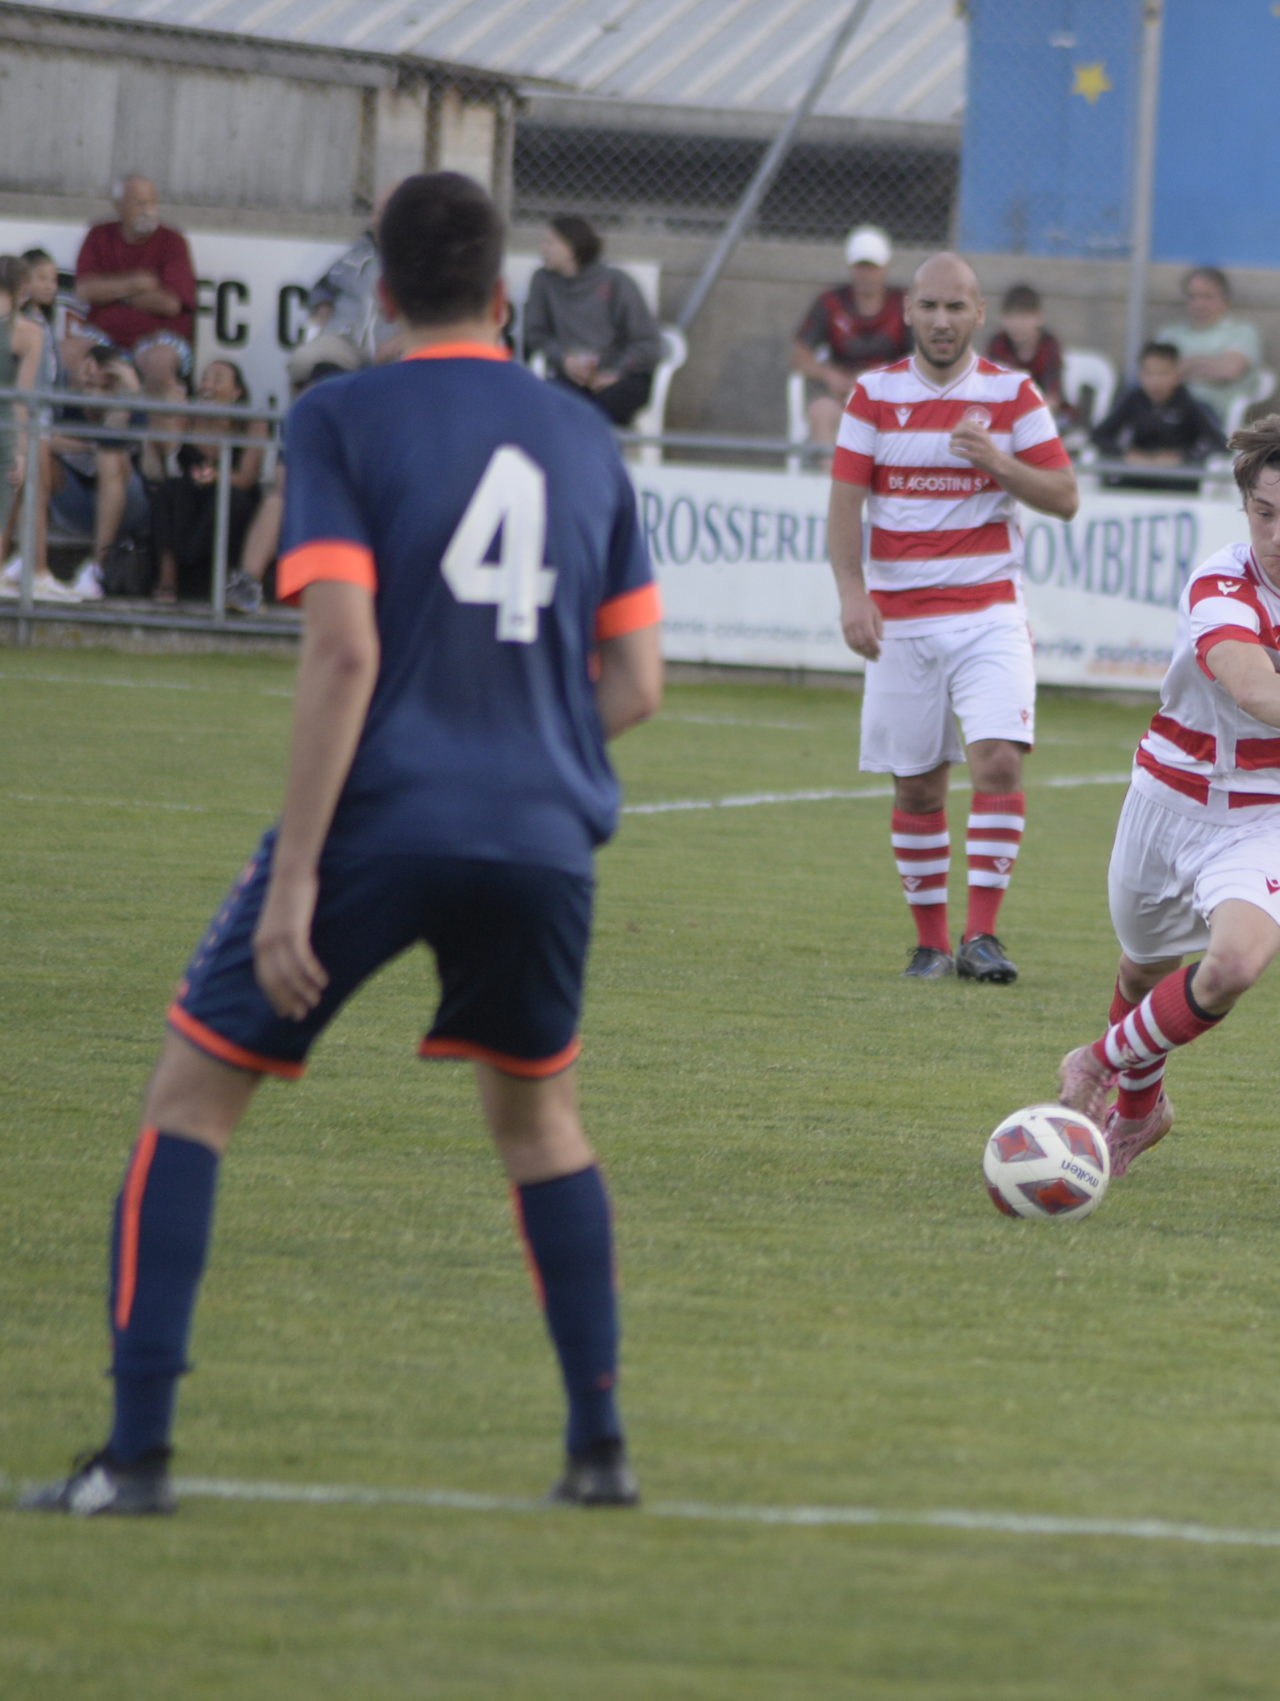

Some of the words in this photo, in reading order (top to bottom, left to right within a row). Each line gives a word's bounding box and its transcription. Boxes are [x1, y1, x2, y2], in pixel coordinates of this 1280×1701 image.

[888, 475, 904, 490] DE
[905, 475, 971, 491] AGOSTINI
[441, 445, 557, 643] 4
[640, 490, 868, 566] ROSSERI
[1060, 1159, 1100, 1189] molten
